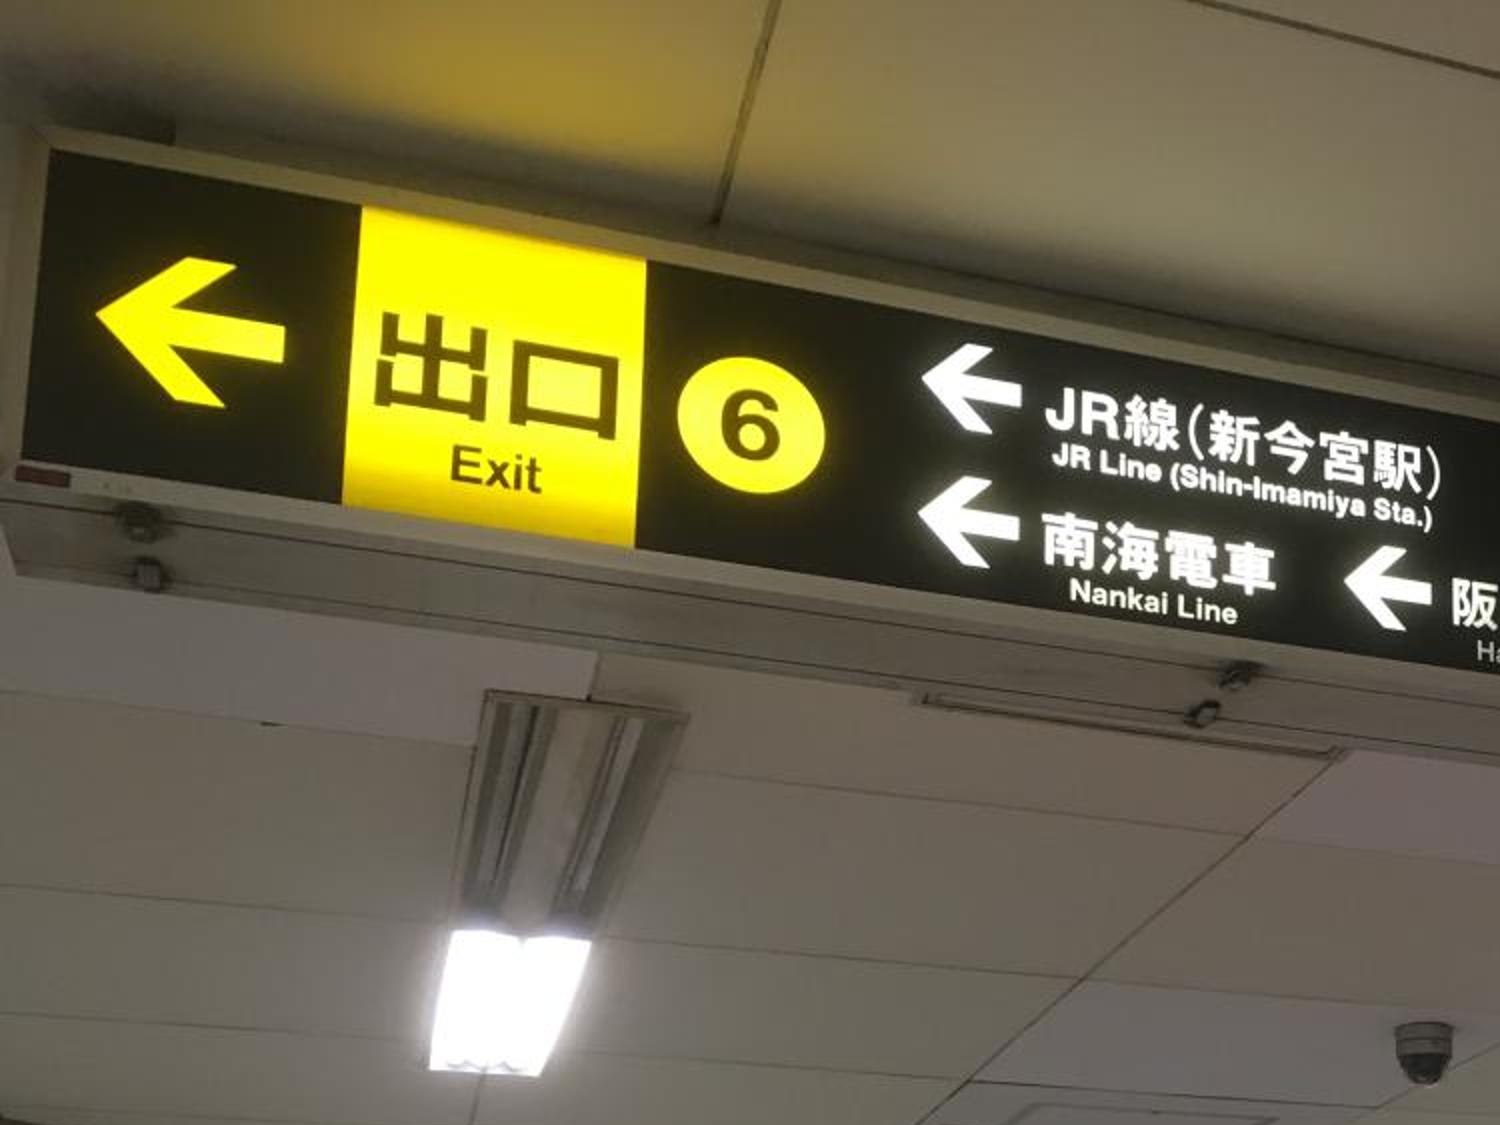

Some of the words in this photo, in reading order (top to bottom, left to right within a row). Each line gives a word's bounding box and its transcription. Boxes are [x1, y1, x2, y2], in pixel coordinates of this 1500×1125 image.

[373, 310, 620, 441] 出口
[720, 388, 782, 462] 6
[449, 443, 544, 495] Exit
[1051, 442, 1091, 471] JR
[1099, 449, 1162, 483] Line
[1169, 461, 1367, 519] (Shin-Imamiya
[1373, 497, 1433, 533] Sta.)
[1041, 511, 1277, 596] 南海電車
[1069, 577, 1169, 615] Nankai
[1177, 595, 1239, 625] Line
